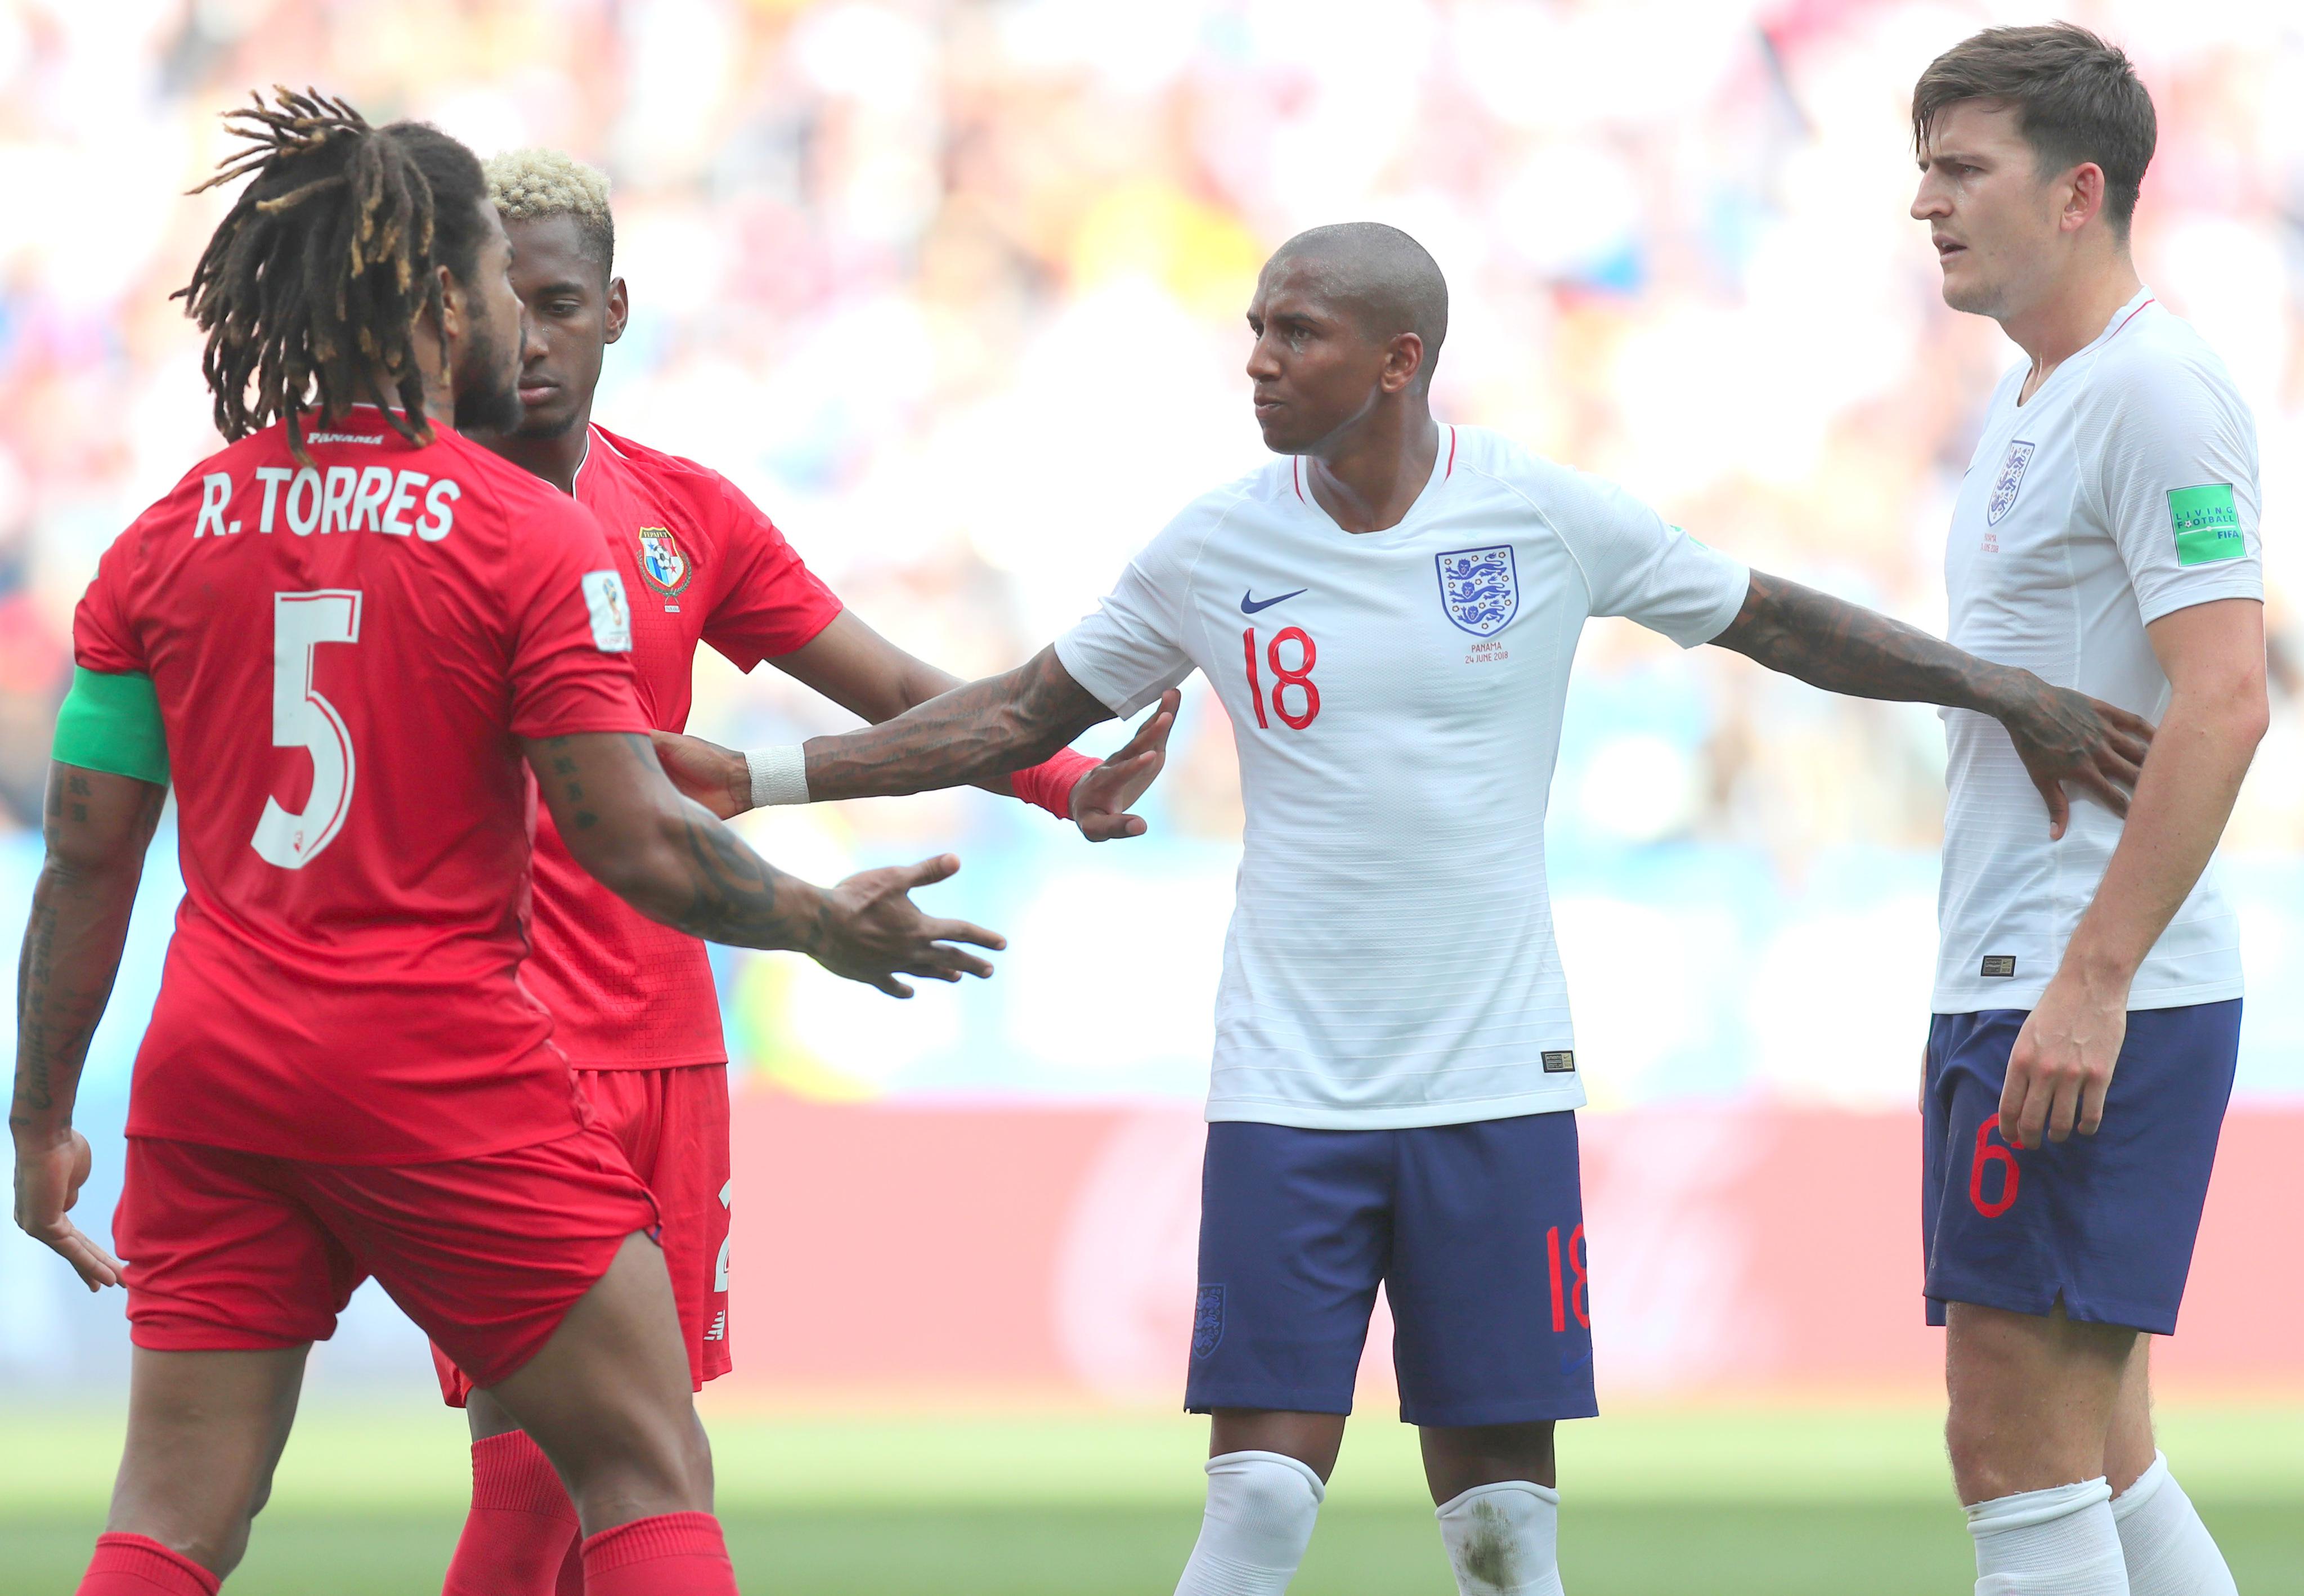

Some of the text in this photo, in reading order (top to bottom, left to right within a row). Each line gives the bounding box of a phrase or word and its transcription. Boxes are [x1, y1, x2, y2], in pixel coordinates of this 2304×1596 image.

[193, 466, 461, 542] R. TORRES
[2176, 506, 2233, 520] LIVING
[2217, 531, 2239, 539] FIFA
[1465, 651, 1509, 663] 24 JUNE 2018
[1471, 642, 1501, 653] PANAMA
[1243, 626, 1320, 730] 18
[250, 589, 362, 869] 5
[1969, 1113, 2025, 1218] 6
